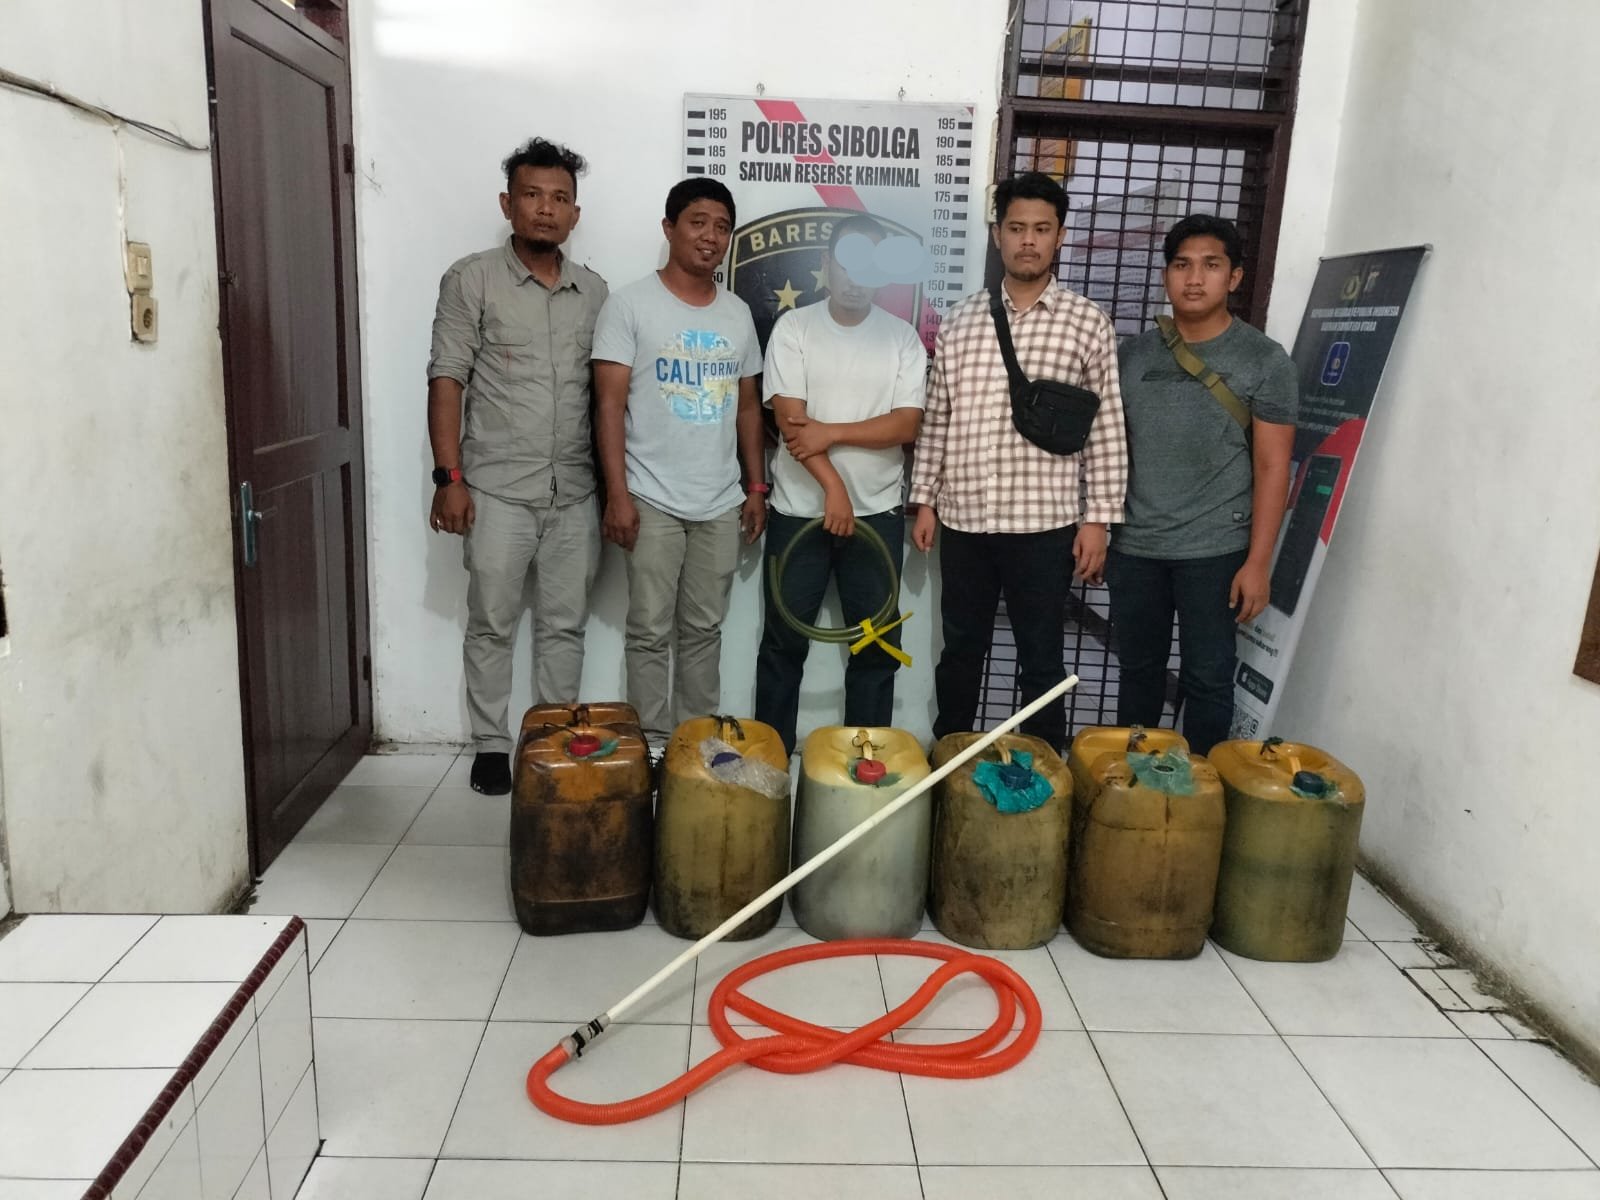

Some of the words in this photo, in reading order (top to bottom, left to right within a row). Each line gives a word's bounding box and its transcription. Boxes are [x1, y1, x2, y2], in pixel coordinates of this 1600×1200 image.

[708, 108, 727, 120] 195
[937, 117, 956, 130] 195
[708, 126, 727, 139] 190
[741, 121, 822, 156] POLRES
[827, 124, 920, 159] SIBOLGA
[936, 136, 954, 148] 190
[708, 144, 726, 157] 185
[936, 154, 953, 166] 185
[707, 163, 726, 175] 180
[739, 160, 792, 183] SATUAN
[794, 162, 853, 185] RESERSE
[855, 165, 920, 187] KRIMINAL
[934, 172, 952, 185] 180
[934, 190, 951, 203] 175
[933, 208, 950, 220] 170
[750, 222, 834, 252] BARES
[931, 226, 948, 239] 165
[930, 244, 948, 256] 160
[933, 262, 946, 273] 55
[928, 279, 945, 291] 150
[927, 297, 943, 308] 145
[926, 314, 942, 325] 140
[925, 331, 938, 342] 13
